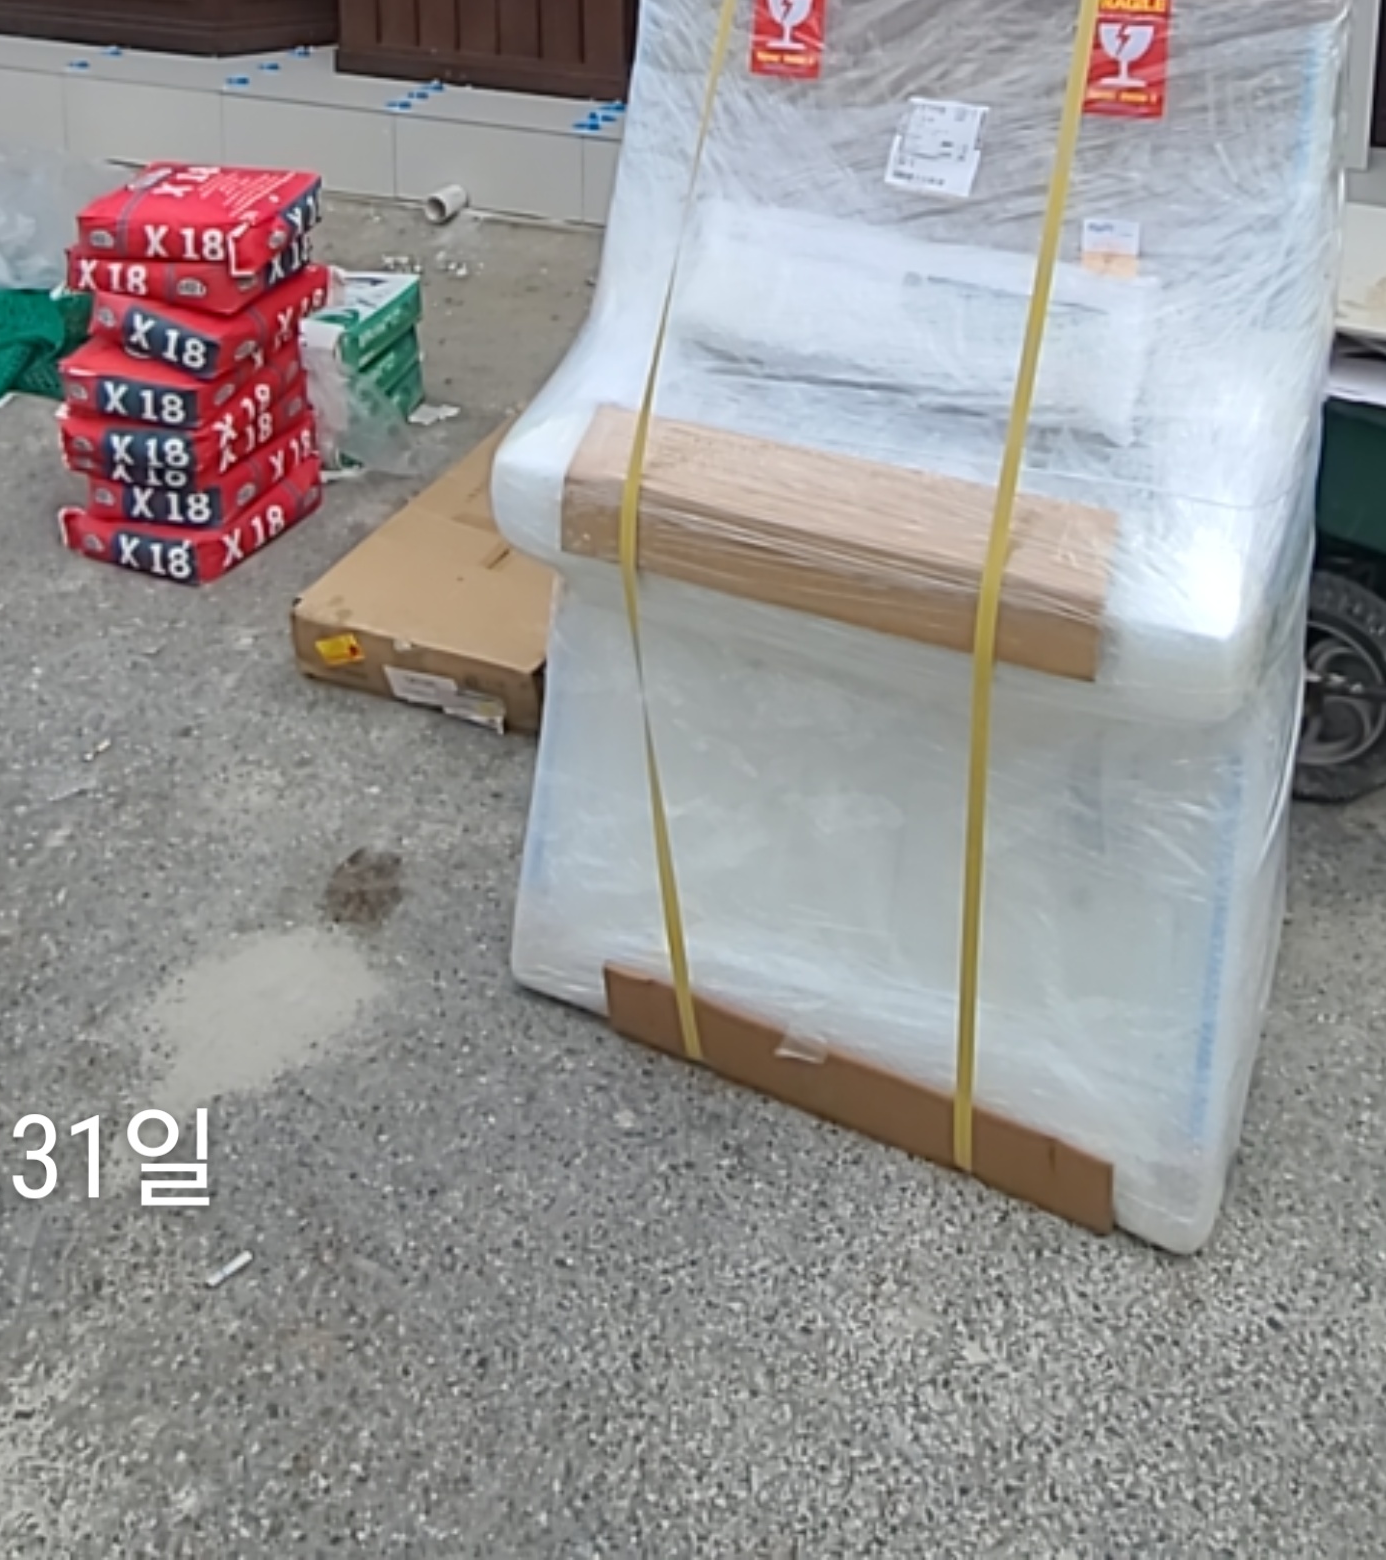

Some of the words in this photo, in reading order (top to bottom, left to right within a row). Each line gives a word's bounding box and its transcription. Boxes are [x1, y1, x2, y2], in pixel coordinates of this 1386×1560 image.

[144, 224, 169, 259] X
[181, 227, 226, 261] 18
[78, 258, 99, 291] X
[107, 262, 148, 295] 18
[129, 312, 155, 350] X
[163, 328, 206, 368] 18
[104, 380, 128, 416] X
[140, 389, 186, 423] 18
[111, 433, 134, 466] X
[146, 437, 189, 468] 18
[131, 487, 154, 519] X
[166, 492, 213, 523] 18
[118, 534, 140, 568] X
[149, 542, 192, 579] 18
[222, 528, 245, 569] X
[250, 504, 285, 546] 18
